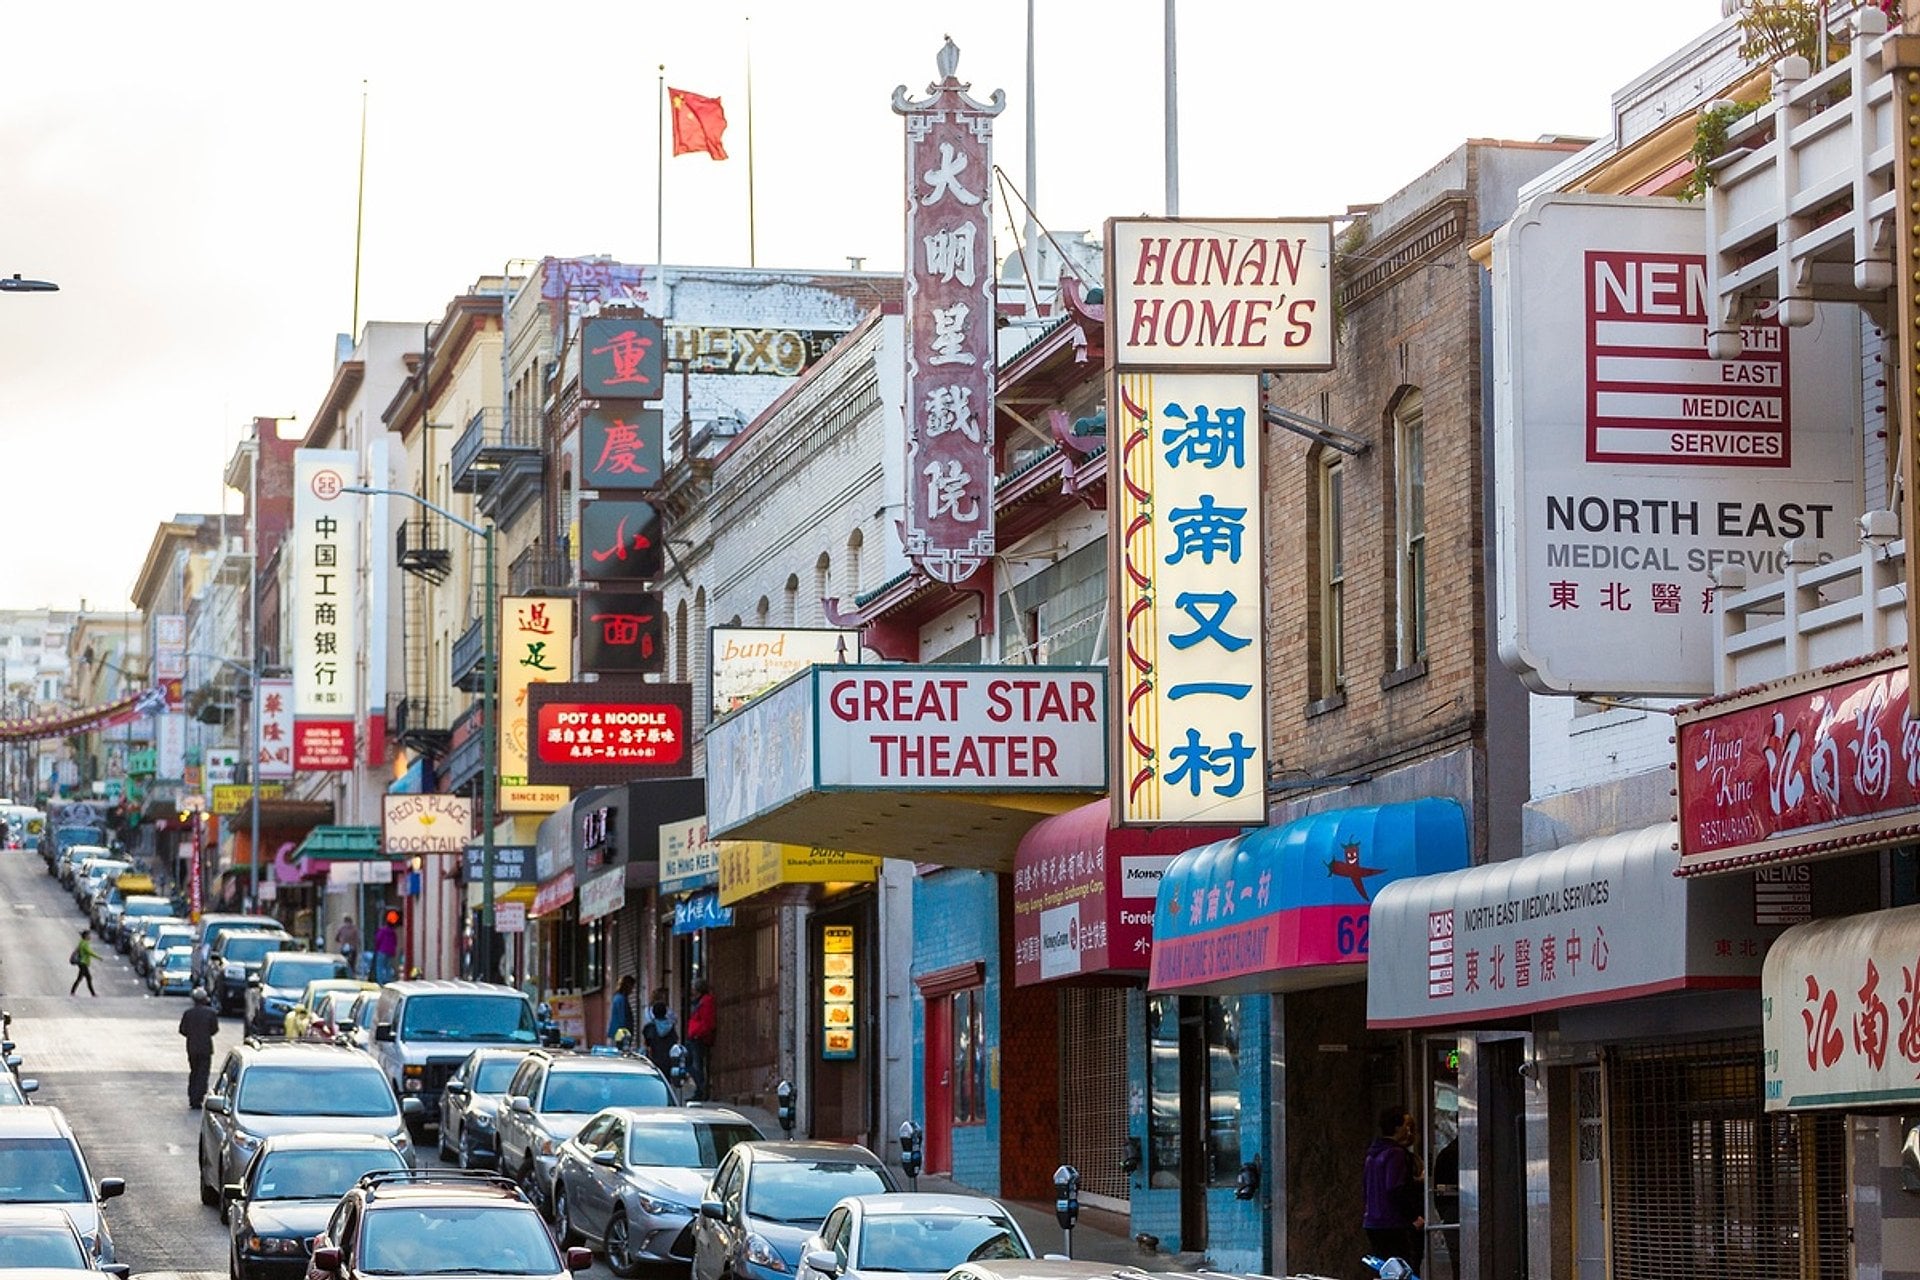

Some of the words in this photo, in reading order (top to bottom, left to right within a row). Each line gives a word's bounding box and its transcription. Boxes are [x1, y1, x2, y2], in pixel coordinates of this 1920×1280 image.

[1133, 238, 1307, 286] HUNAN
[1126, 293, 1317, 348] HOME'S
[1722, 363, 1779, 385] EAST
[1681, 397, 1780, 420] MEDICAL
[1670, 432, 1780, 455] SERVICES
[591, 330, 653, 647] 重慶小面
[1546, 495, 1700, 536] NORTH
[1717, 502, 1833, 540] EAST
[1546, 543, 1680, 572] MEDICAL
[1687, 547, 1834, 575] SERVICS
[313, 515, 338, 686] 中国工商银行
[1162, 401, 1257, 798] 湖南又一村
[722, 633, 785, 661] bund
[830, 679, 968, 723] GREAT
[986, 680, 1097, 723] STAR
[557, 712, 589, 725] POT
[592, 712, 603, 725] &
[605, 712, 667, 725] NOODLE
[869, 735, 1059, 778] THEATER
[388, 795, 425, 825] RED'S
[428, 797, 470, 826] PLACE
[511, 793, 537, 802] SINCE
[540, 793, 561, 802] 2001
[387, 836, 470, 853] COCKTAILS
[1700, 815, 1760, 846] RESTAURANT
[786, 858, 825, 867] Shanghai
[827, 857, 874, 866] Restaurant
[1190, 867, 1272, 927] 湖南又一村
[1464, 906, 1495, 932] NORTH
[1496, 900, 1520, 926] EAST
[1521, 890, 1561, 922] MEDICAL
[1562, 879, 1610, 912] SERVICES
[1133, 937, 1150, 955] 外
[1464, 925, 1610, 994] 東北醫療中心
